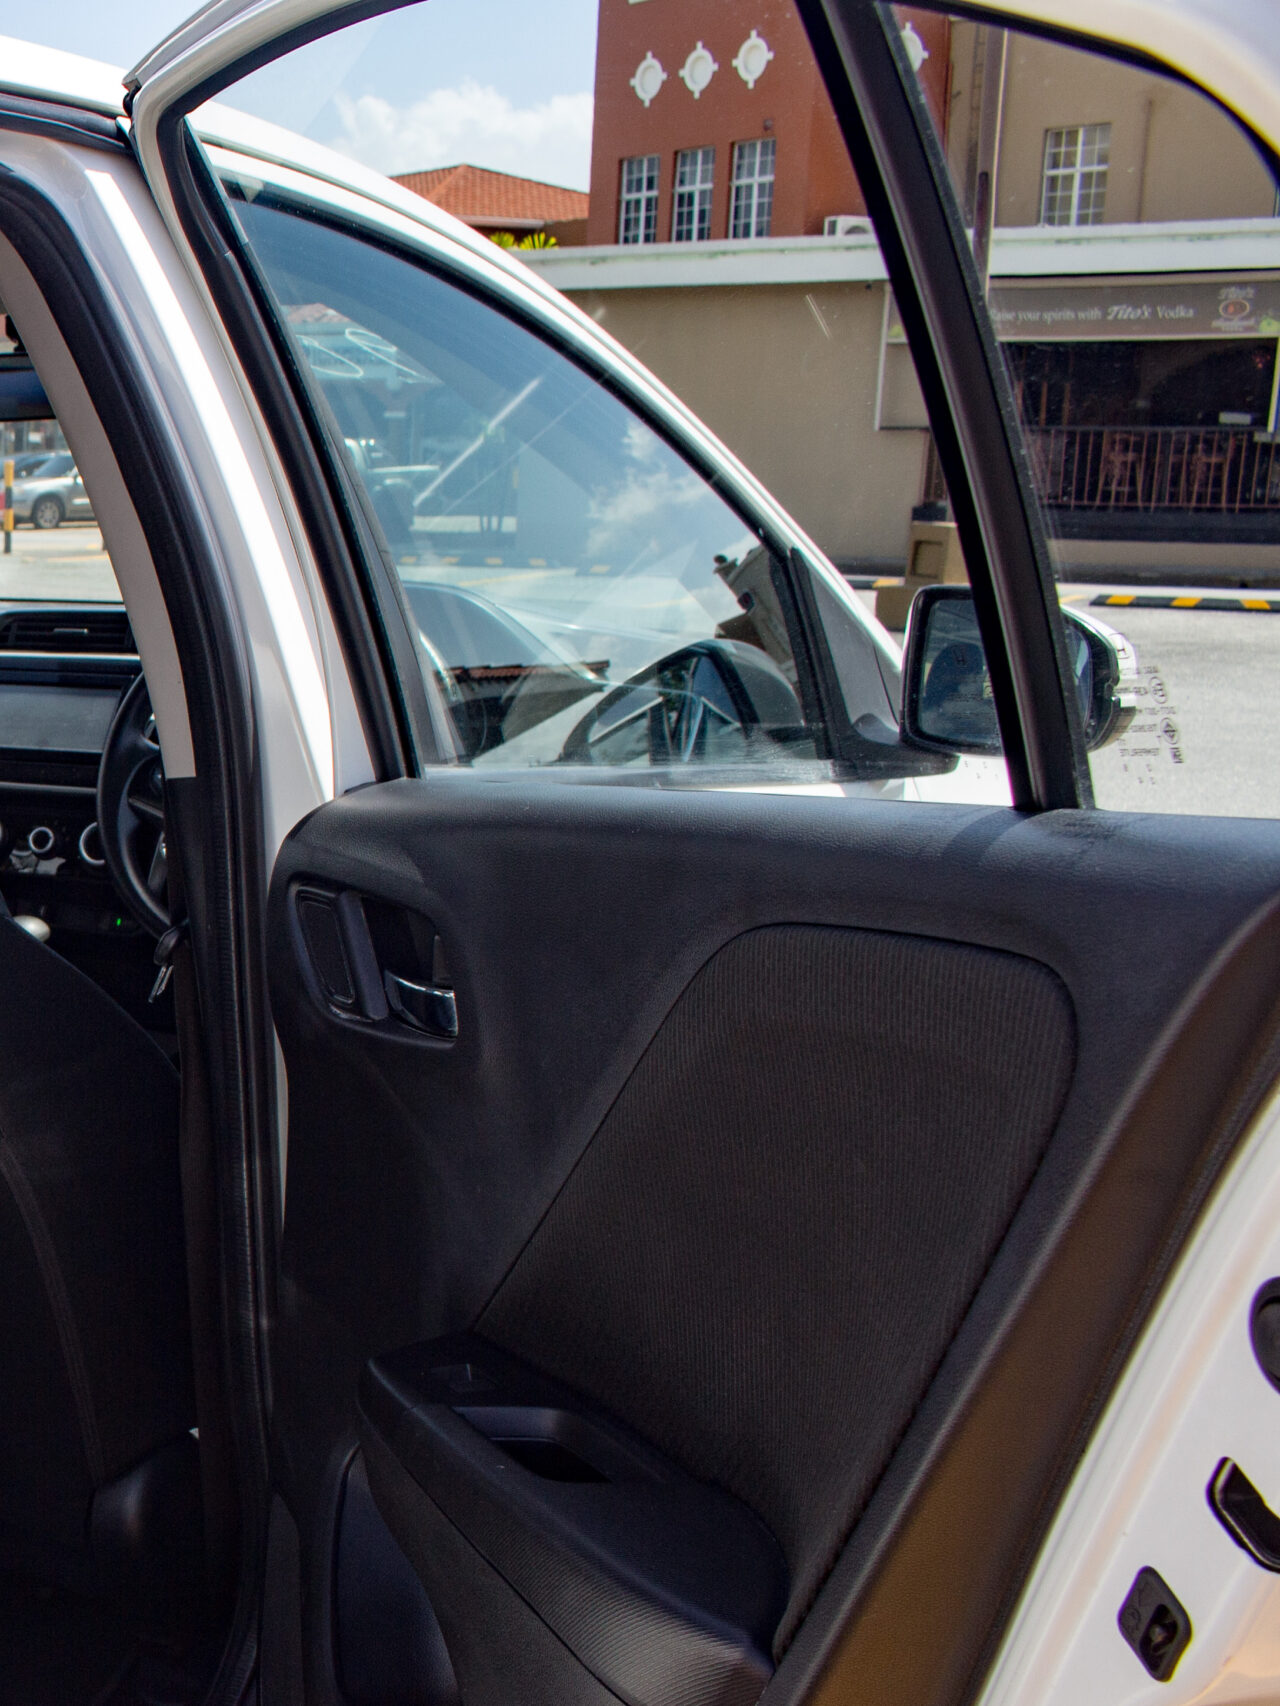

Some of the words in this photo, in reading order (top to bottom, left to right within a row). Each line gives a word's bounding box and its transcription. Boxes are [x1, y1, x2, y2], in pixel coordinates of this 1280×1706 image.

[1017, 310, 1041, 324] your
[1041, 307, 1076, 324] spirits
[1078, 305, 1103, 320] with
[1106, 304, 1152, 320] Tito's
[1156, 304, 1195, 320] Vodka
